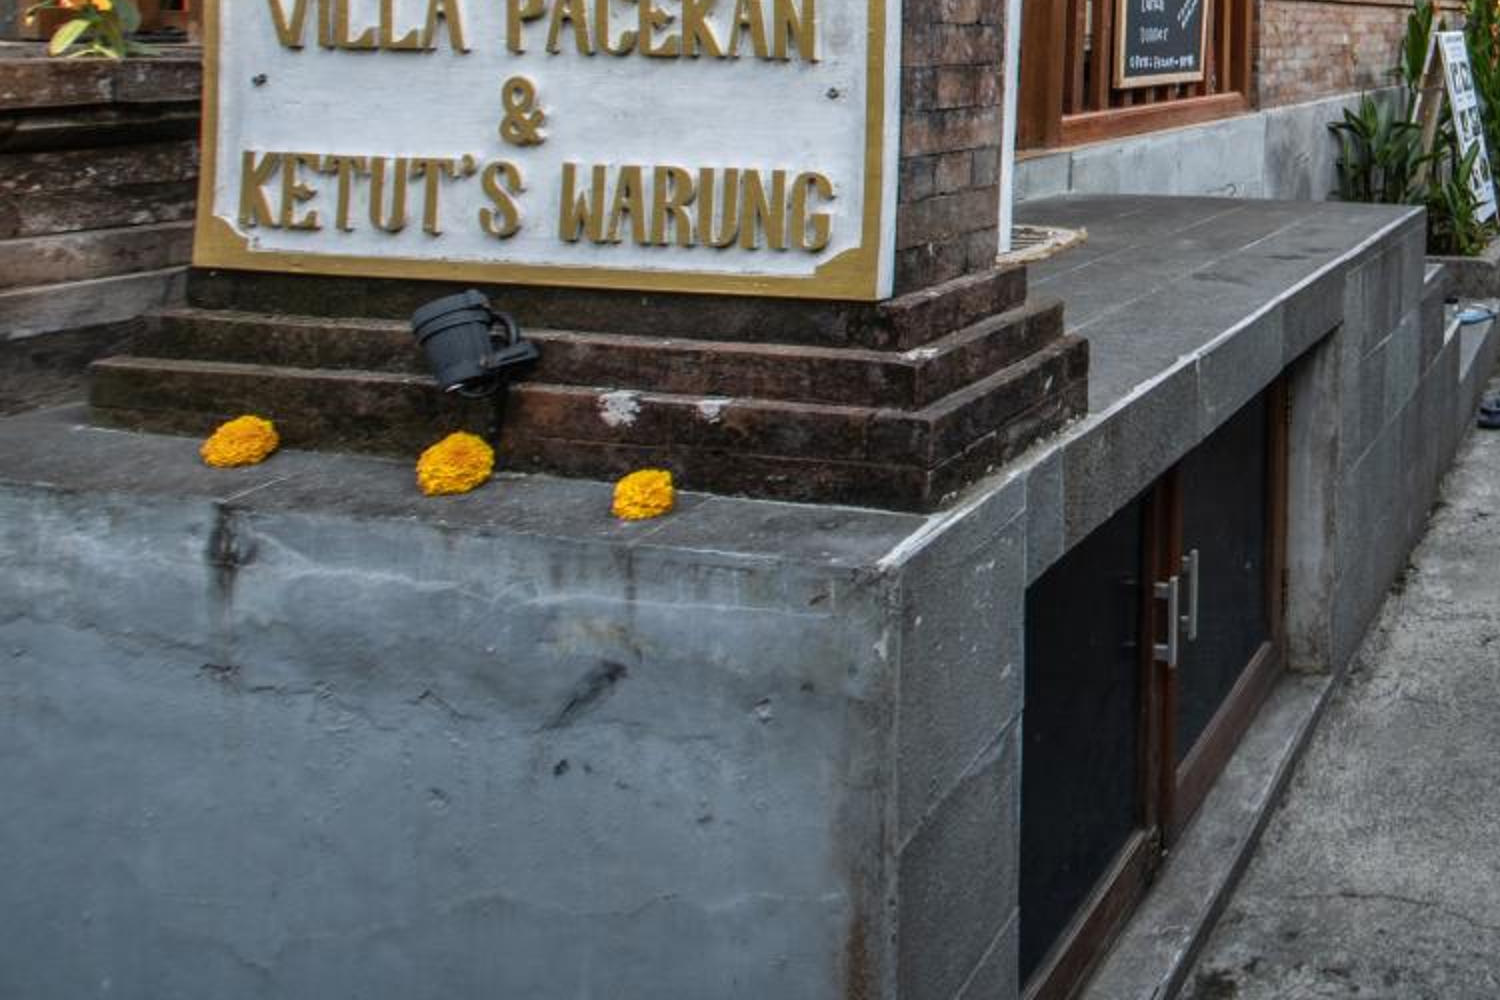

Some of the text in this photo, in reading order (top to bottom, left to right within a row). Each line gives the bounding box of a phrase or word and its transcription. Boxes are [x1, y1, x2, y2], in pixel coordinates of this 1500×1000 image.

[500, 74, 547, 147] &
[239, 149, 837, 253] KETUT'S WARUNG
